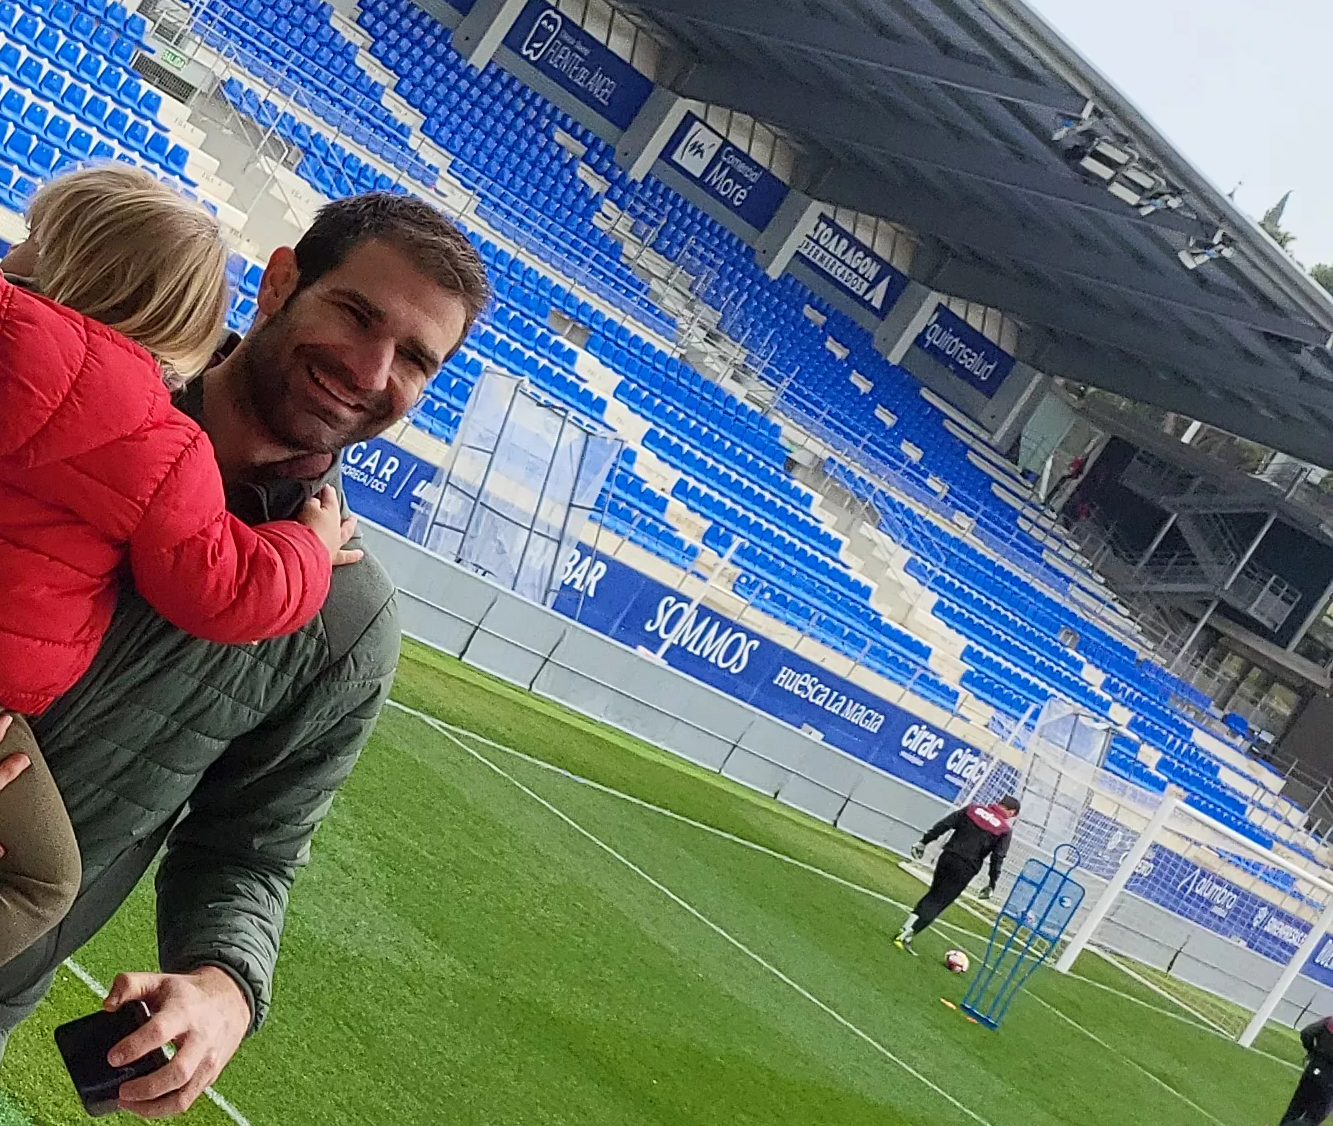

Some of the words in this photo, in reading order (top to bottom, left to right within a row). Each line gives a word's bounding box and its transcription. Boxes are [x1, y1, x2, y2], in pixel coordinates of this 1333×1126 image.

[705, 162, 750, 206] Moré
[645, 595, 760, 674] SOMMOS
[899, 719, 947, 762] cirac
